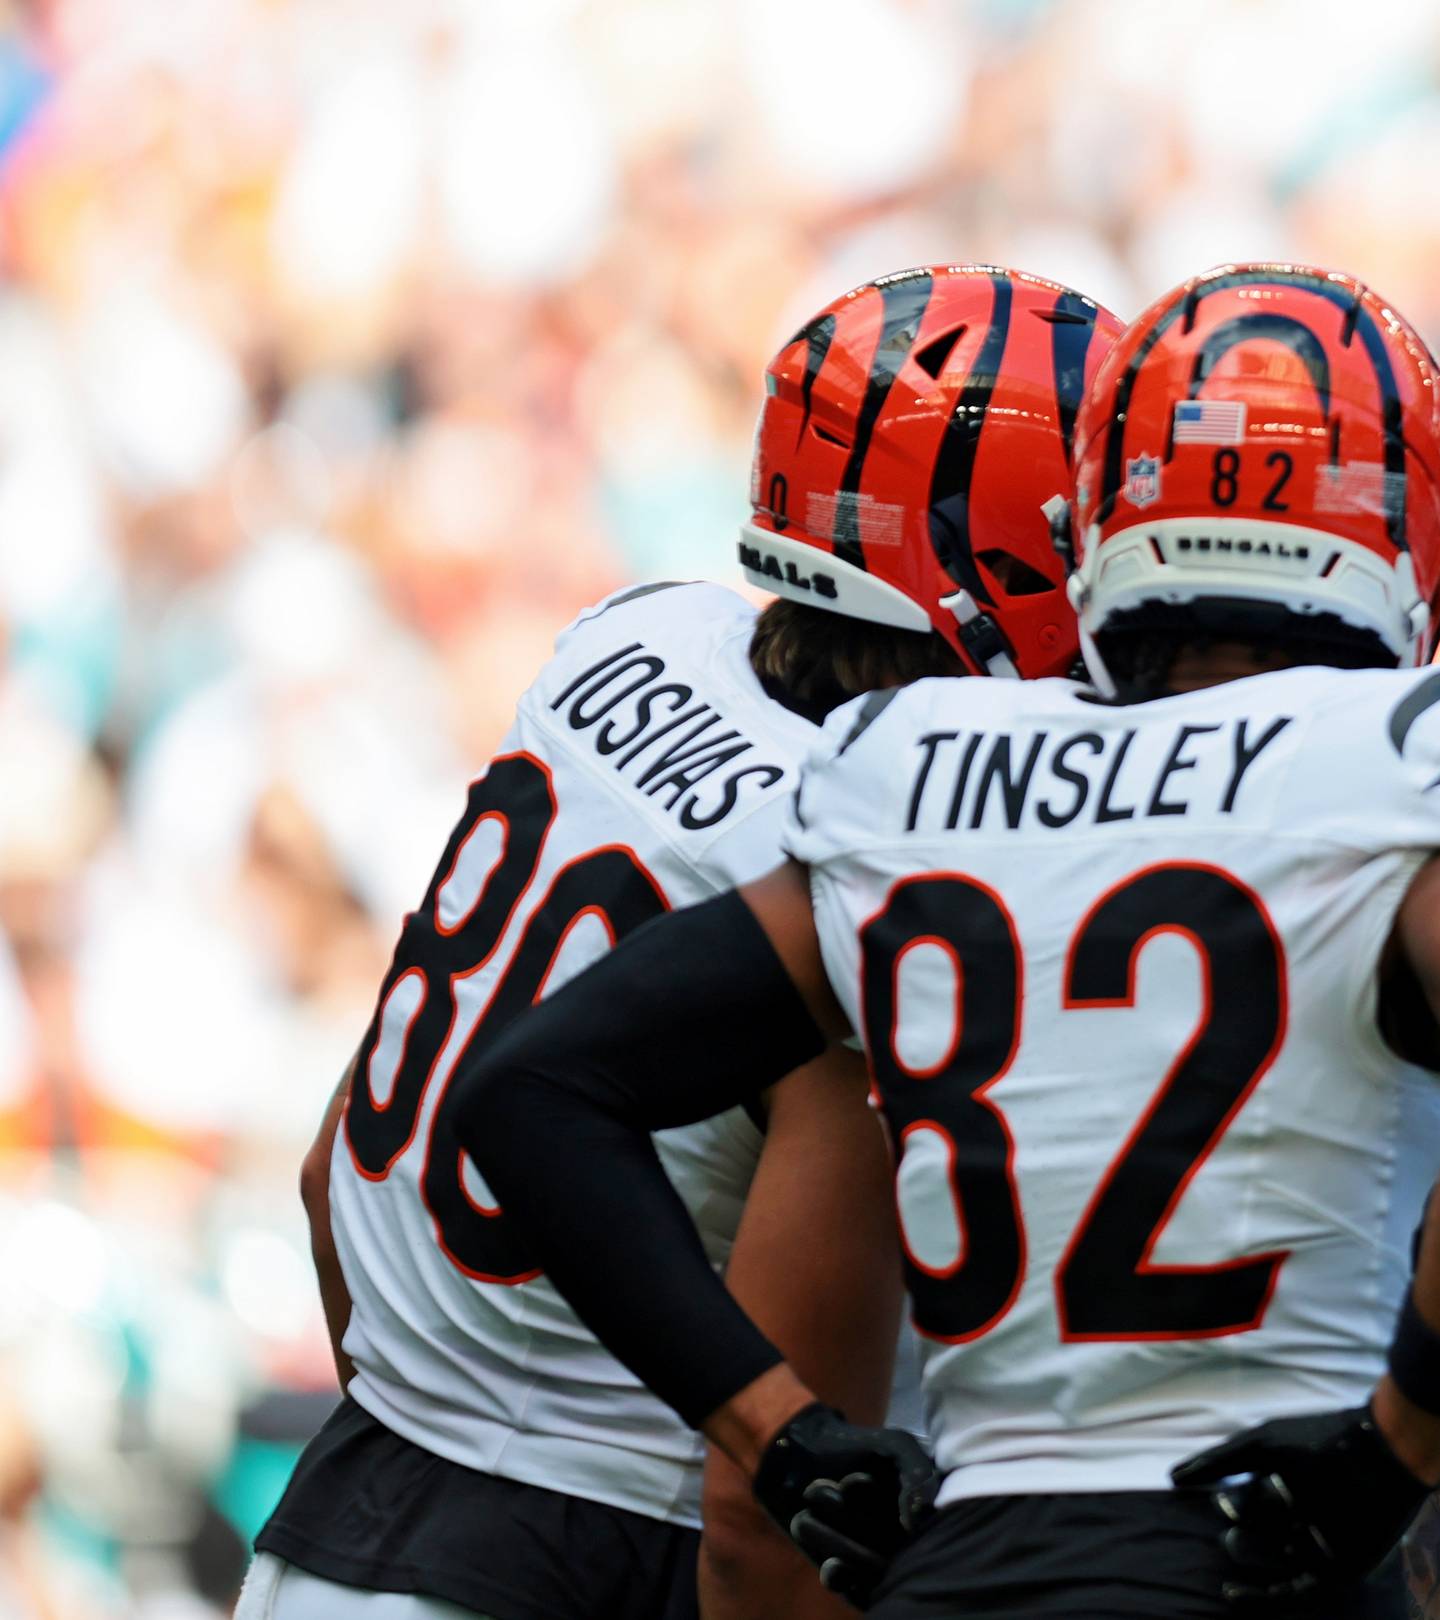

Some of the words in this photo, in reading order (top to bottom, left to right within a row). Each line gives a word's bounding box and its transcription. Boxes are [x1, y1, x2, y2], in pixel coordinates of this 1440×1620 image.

[1210, 449, 1294, 511] 82
[1177, 536, 1309, 560] BENGALS
[549, 642, 784, 830] IOSIVAS
[904, 715, 1294, 832] TINSLEY
[858, 858, 1291, 1344] 82
